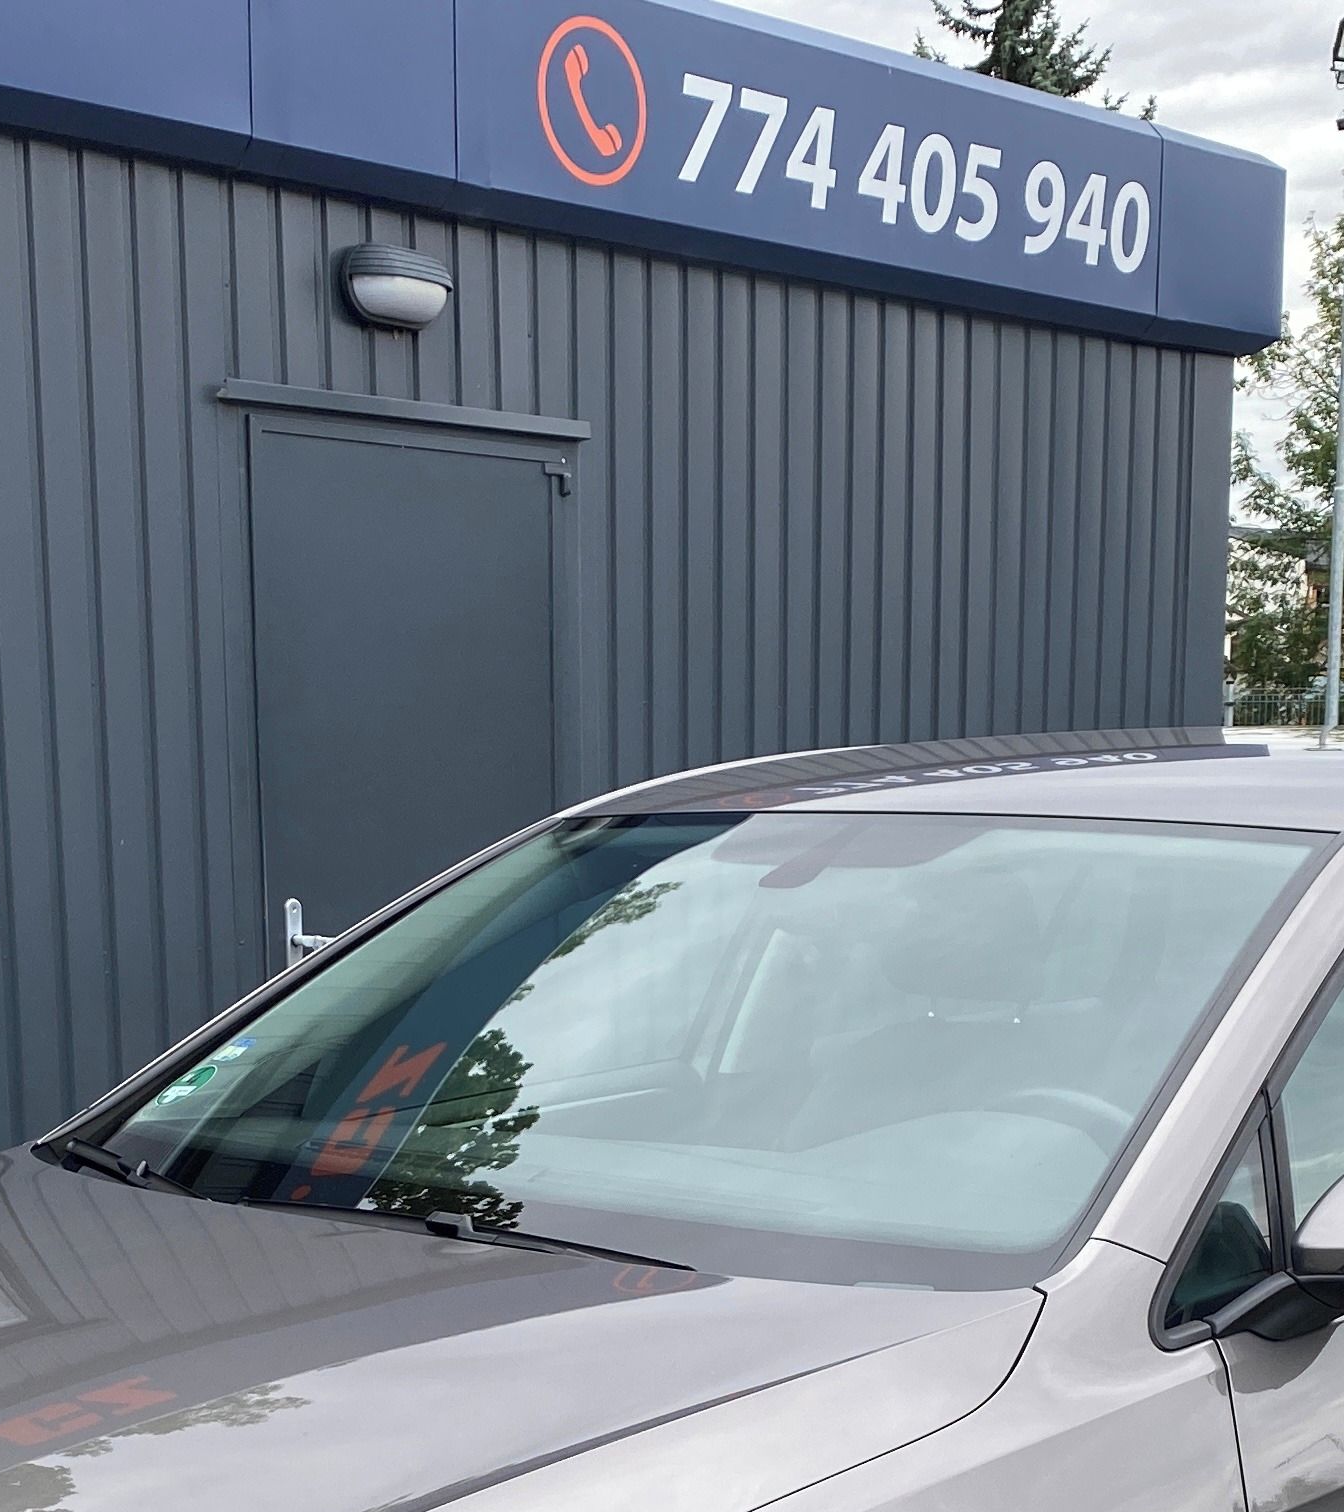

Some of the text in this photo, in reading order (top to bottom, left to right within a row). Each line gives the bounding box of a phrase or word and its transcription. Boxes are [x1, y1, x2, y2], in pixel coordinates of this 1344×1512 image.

[677, 71, 1151, 275] 774 405 940
